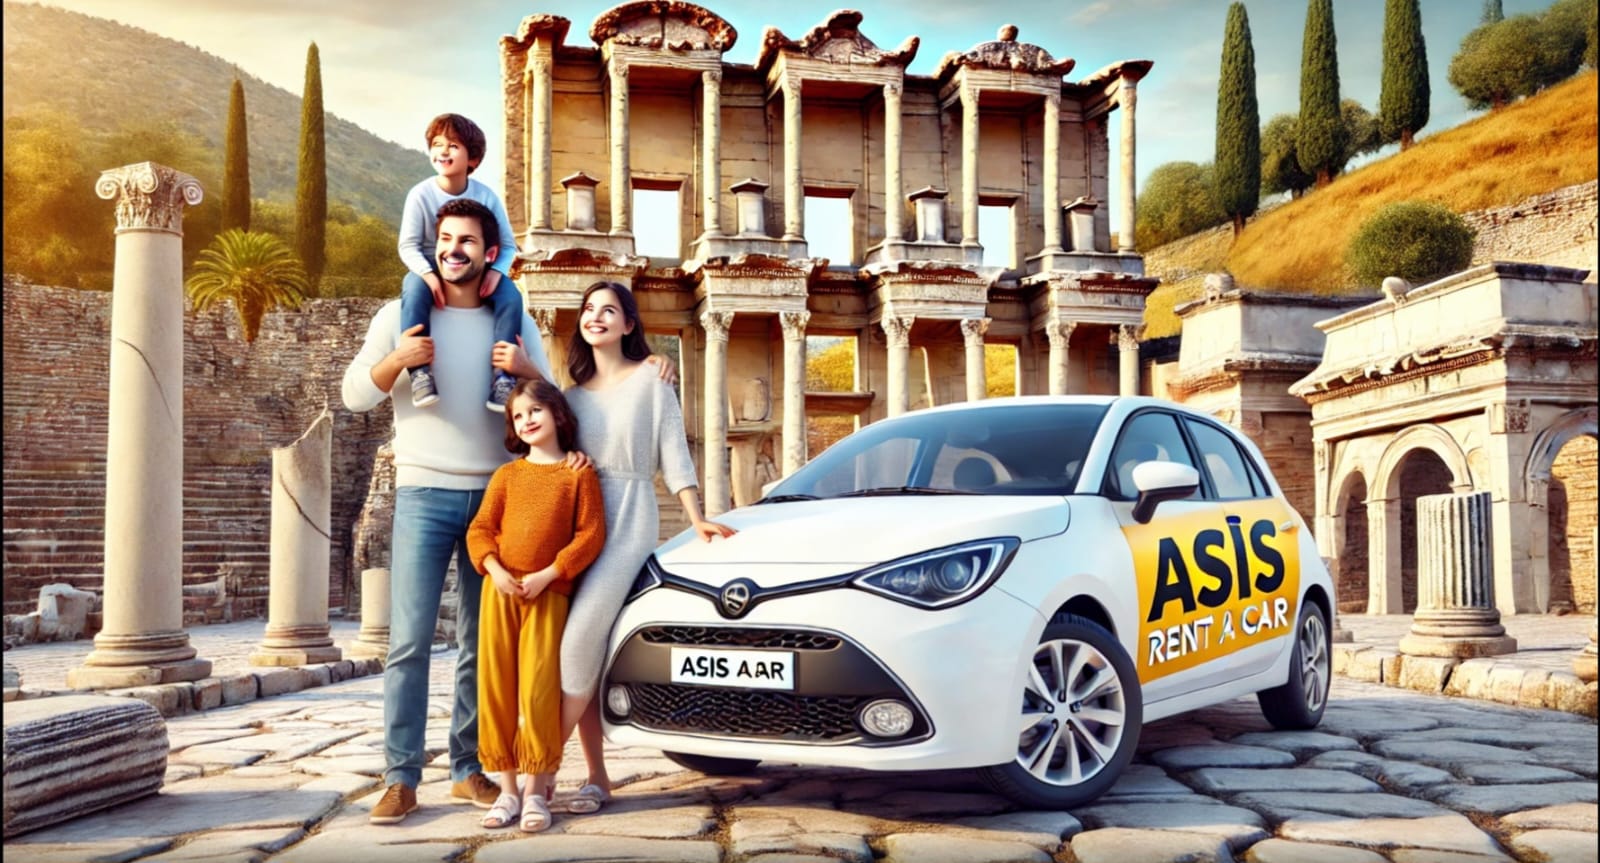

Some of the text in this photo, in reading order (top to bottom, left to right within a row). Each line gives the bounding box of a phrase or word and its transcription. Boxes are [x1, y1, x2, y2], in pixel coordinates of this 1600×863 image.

[1148, 597, 1288, 666] RENT A CAR
[680, 656, 729, 678] ASIS
